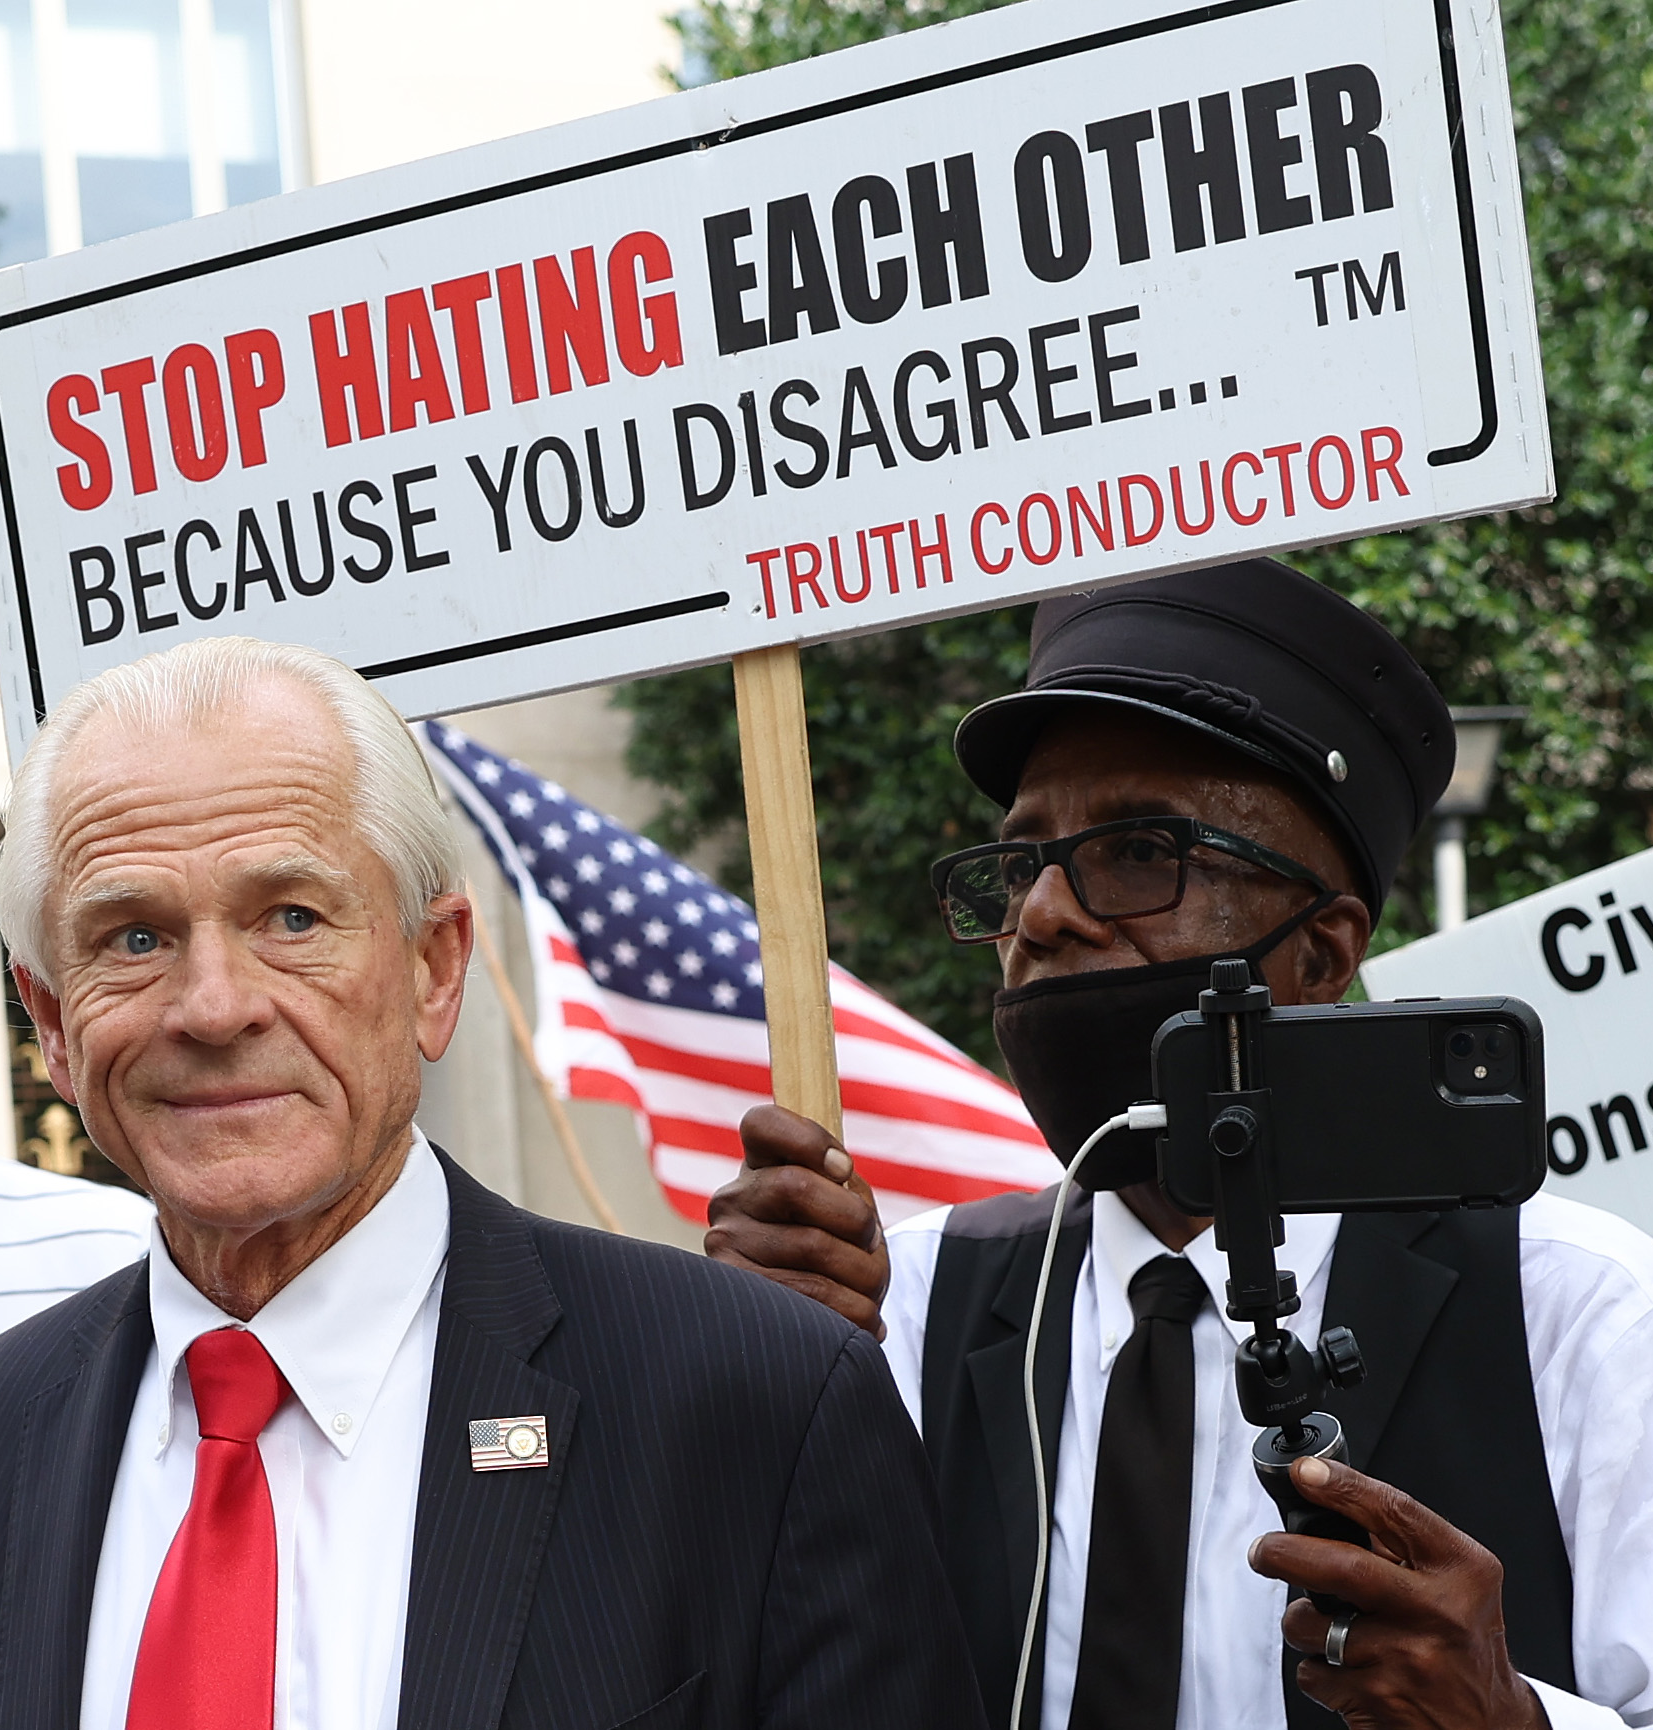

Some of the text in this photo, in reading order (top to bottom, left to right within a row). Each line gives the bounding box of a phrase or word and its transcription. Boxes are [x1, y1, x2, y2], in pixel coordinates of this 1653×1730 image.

[46, 62, 1395, 512] STOP HATING EACH OTHER
[1293, 249, 1407, 328] TM
[67, 303, 1240, 648] BECAUSE YOU DISAGREE...
[745, 425, 1411, 621] TRUTH CONDUCTOR
